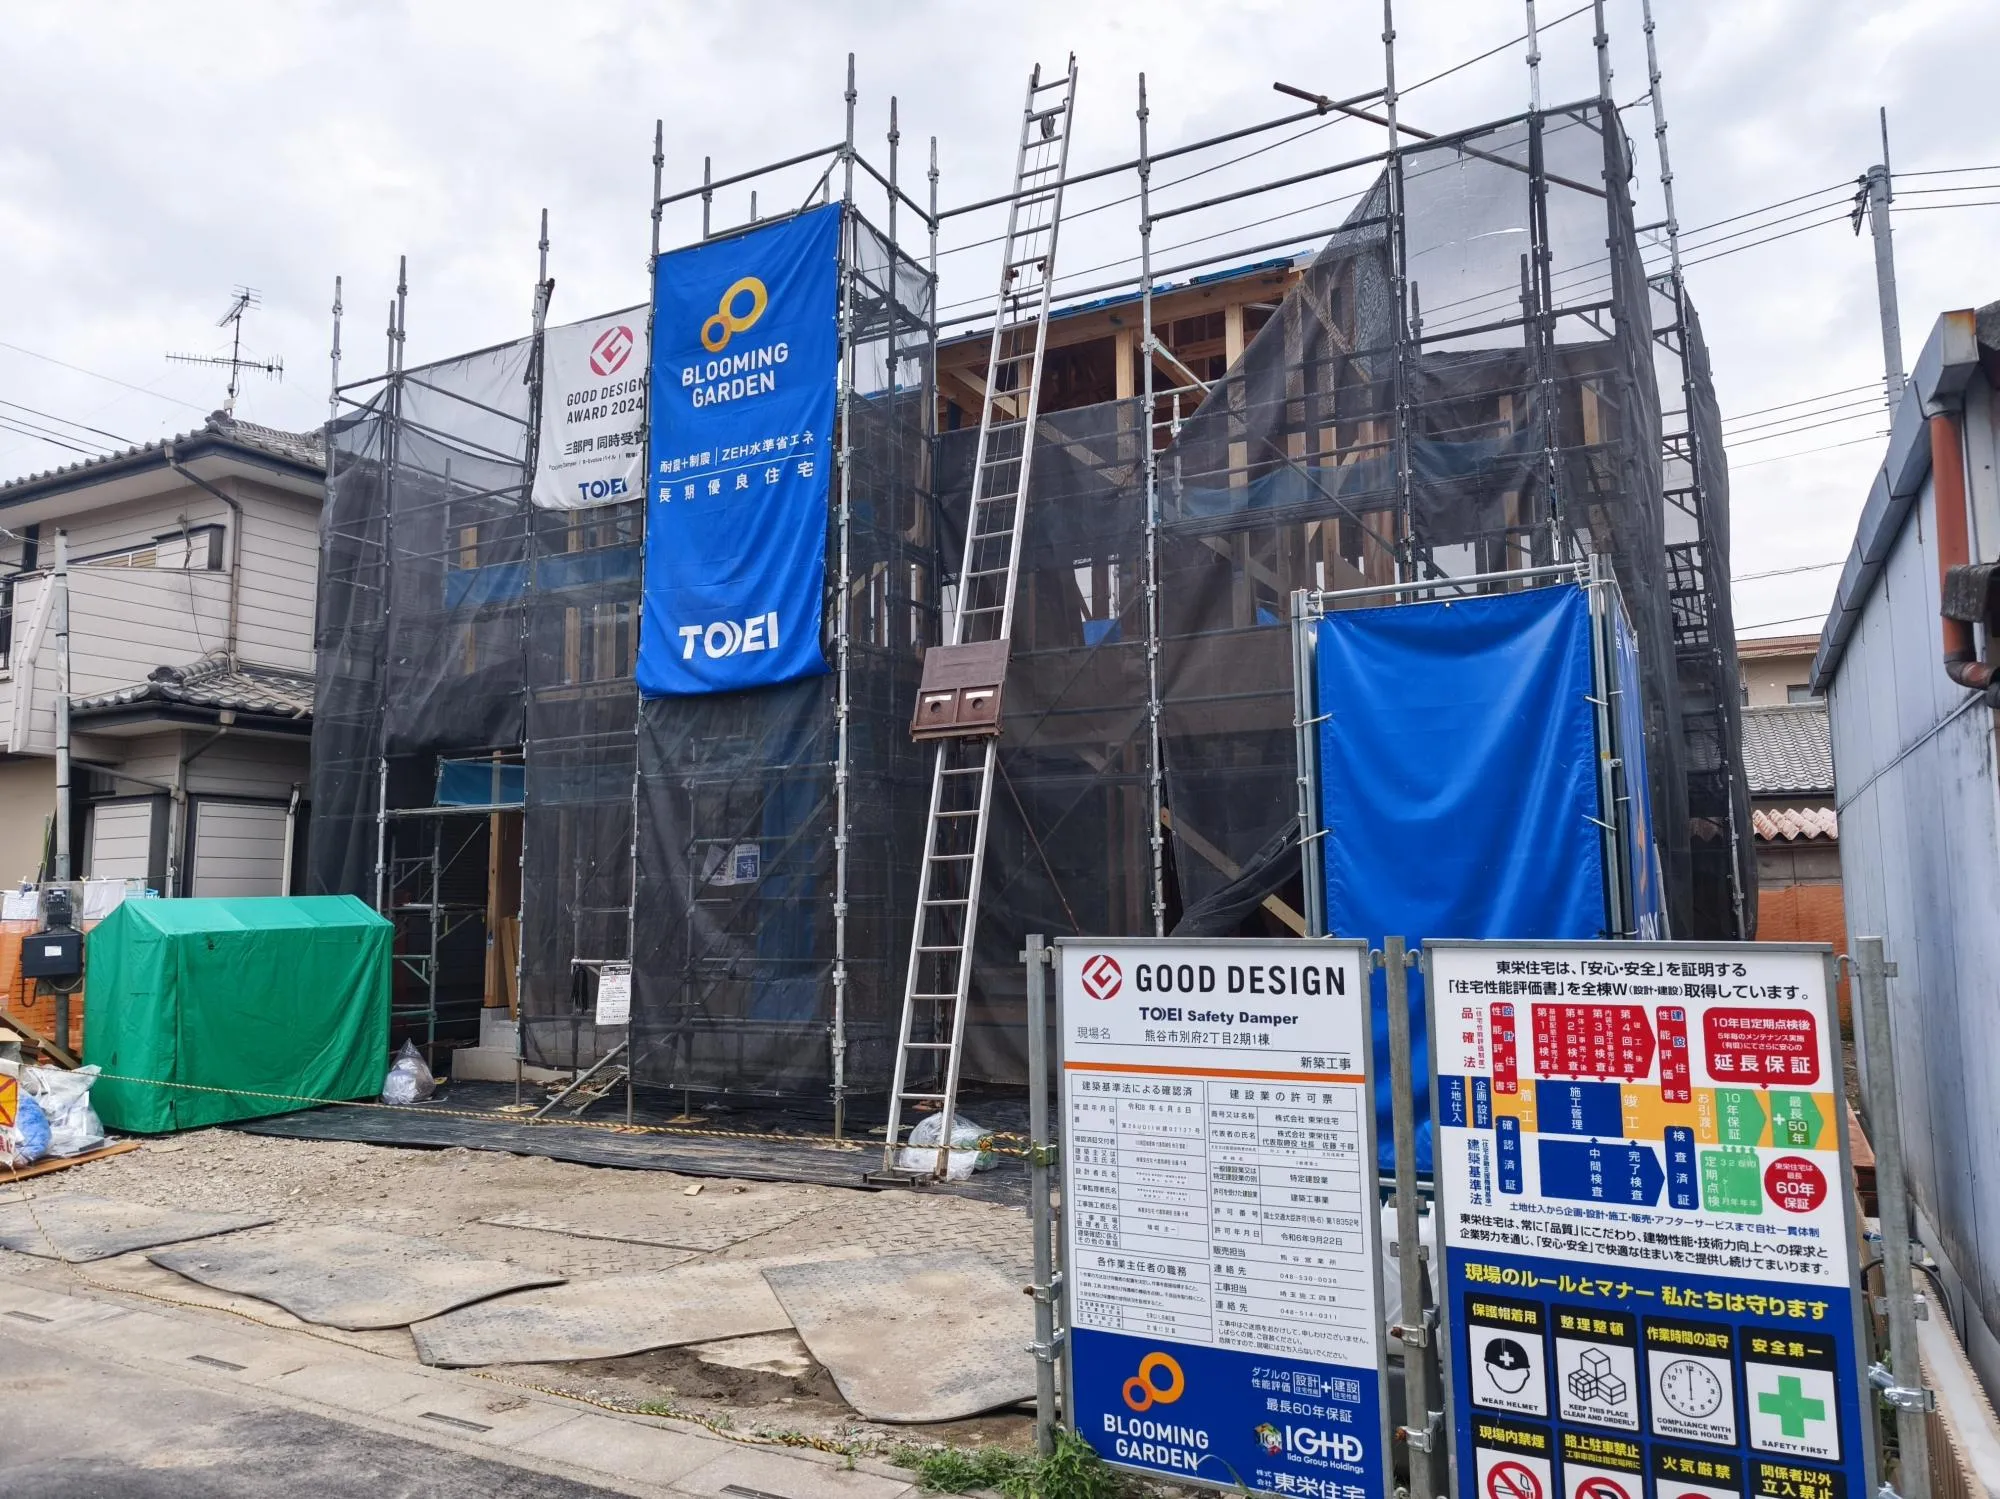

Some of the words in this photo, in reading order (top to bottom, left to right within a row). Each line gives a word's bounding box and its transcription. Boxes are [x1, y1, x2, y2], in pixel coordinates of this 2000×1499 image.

[682, 343, 788, 386] BLOOMING
[566, 389, 597, 407] GOOD
[692, 370, 775, 408] GARDEN
[566, 405, 607, 425] AWARD
[611, 396, 644, 416] 2024
[563, 438, 594, 456] 三部門
[659, 461, 813, 503] 長期優良住宅
[679, 611, 779, 660] TOEI
[1136, 963, 1216, 993] GOOD
[1228, 965, 1345, 996] DESIGN
[1496, 960, 1747, 978] 東栄住宅は、「安心・安全」を証明する
[1138, 1006, 1182, 1022] TOEI
[1187, 1010, 1234, 1026] Safety
[1239, 1011, 1299, 1027] Damper
[1712, 1017, 1811, 1031] 10年目定期点検後
[1077, 1026, 1111, 1040] 現場名
[1144, 1029, 1270, 1047] 熊谷市別府2丁目2期1棟
[1461, 1007, 1476, 1069] 品確法
[1537, 1007, 1549, 1070] 第1回検査
[1565, 1008, 1578, 1071] 第2回検査
[1592, 1009, 1606, 1072] 第3回検査
[1620, 1009, 1634, 1074] 第4回検査
[1300, 1056, 1351, 1071] 新築工事
[1714, 1054, 1812, 1075] 延長保証
[1082, 1080, 1192, 1097] 建築基準法による確認済
[1230, 1089, 1333, 1104] 建設業の許可票
[1450, 1080, 1462, 1123] 土地仕入
[1520, 1089, 1533, 1123] 着工
[1569, 1086, 1583, 1130] 施工管理
[1624, 1094, 1640, 1129] 竣工
[1698, 1093, 1711, 1140] お引渡し
[1725, 1092, 1741, 1140] 10年保証
[1502, 1119, 1516, 1191] 確認済証
[1290, 1174, 1328, 1184] 特定建設業
[1467, 1138, 1482, 1205] 建築基準法
[1589, 1148, 1603, 1197] 中間検査
[1628, 1151, 1643, 1201] 完了検査
[1673, 1130, 1690, 1206] 検査済証
[1704, 1156, 1720, 1207] 定期点検
[1776, 1182, 1815, 1197] 60年
[1784, 1197, 1810, 1210] 保証
[1213, 1245, 1246, 1258] 販売担当
[1097, 1256, 1187, 1277] 各作業主任者の職務
[1214, 1281, 1247, 1294] 工事担当
[1465, 1263, 1655, 1299] 現場のルールとマナー
[1661, 1285, 1829, 1320] 私たちは守ります
[1472, 1303, 1537, 1324] 保護帽着用
[1560, 1315, 1624, 1336] 整理整頓
[1647, 1326, 1728, 1349] 作業時間の遵守
[1752, 1338, 1823, 1357] 安全第一
[1251, 1367, 1290, 1382] ダブルの
[1251, 1379, 1291, 1393] 性能評価
[1294, 1372, 1319, 1388] 設計
[1334, 1379, 1358, 1394] 建設
[1266, 1397, 1353, 1423] 最長60年保証
[1481, 1396, 1504, 1406] WEAR
[1506, 1401, 1538, 1412] HELMET
[1568, 1403, 1587, 1411] KEEP
[1606, 1409, 1629, 1418] PLACE
[1563, 1410, 1586, 1420] CLEAN
[1587, 1414, 1602, 1422] AND
[1603, 1415, 1636, 1427] ORDERLY
[1657, 1417, 1709, 1430] COMPLIANCE
[1710, 1424, 1732, 1433] WITH
[1103, 1413, 1209, 1450] BLOOMING
[1479, 1425, 1545, 1449] 現場内禁煙
[1660, 1424, 1698, 1436] WORKING
[1700, 1430, 1729, 1441] HOURS
[1116, 1439, 1199, 1471] GARDEN
[1285, 1425, 1363, 1463] IGHD
[1564, 1433, 1640, 1459] 路上駐車禁止
[1761, 1440, 1798, 1451] SAFETY
[1800, 1445, 1828, 1455] FIRST
[1303, 1456, 1328, 1469] Group
[1330, 1461, 1364, 1475] Holdings
[1662, 1456, 1732, 1480] 火気厳禁
[1760, 1463, 1833, 1488] 関係者以外
[1762, 1479, 1834, 1499] 立入禁止
